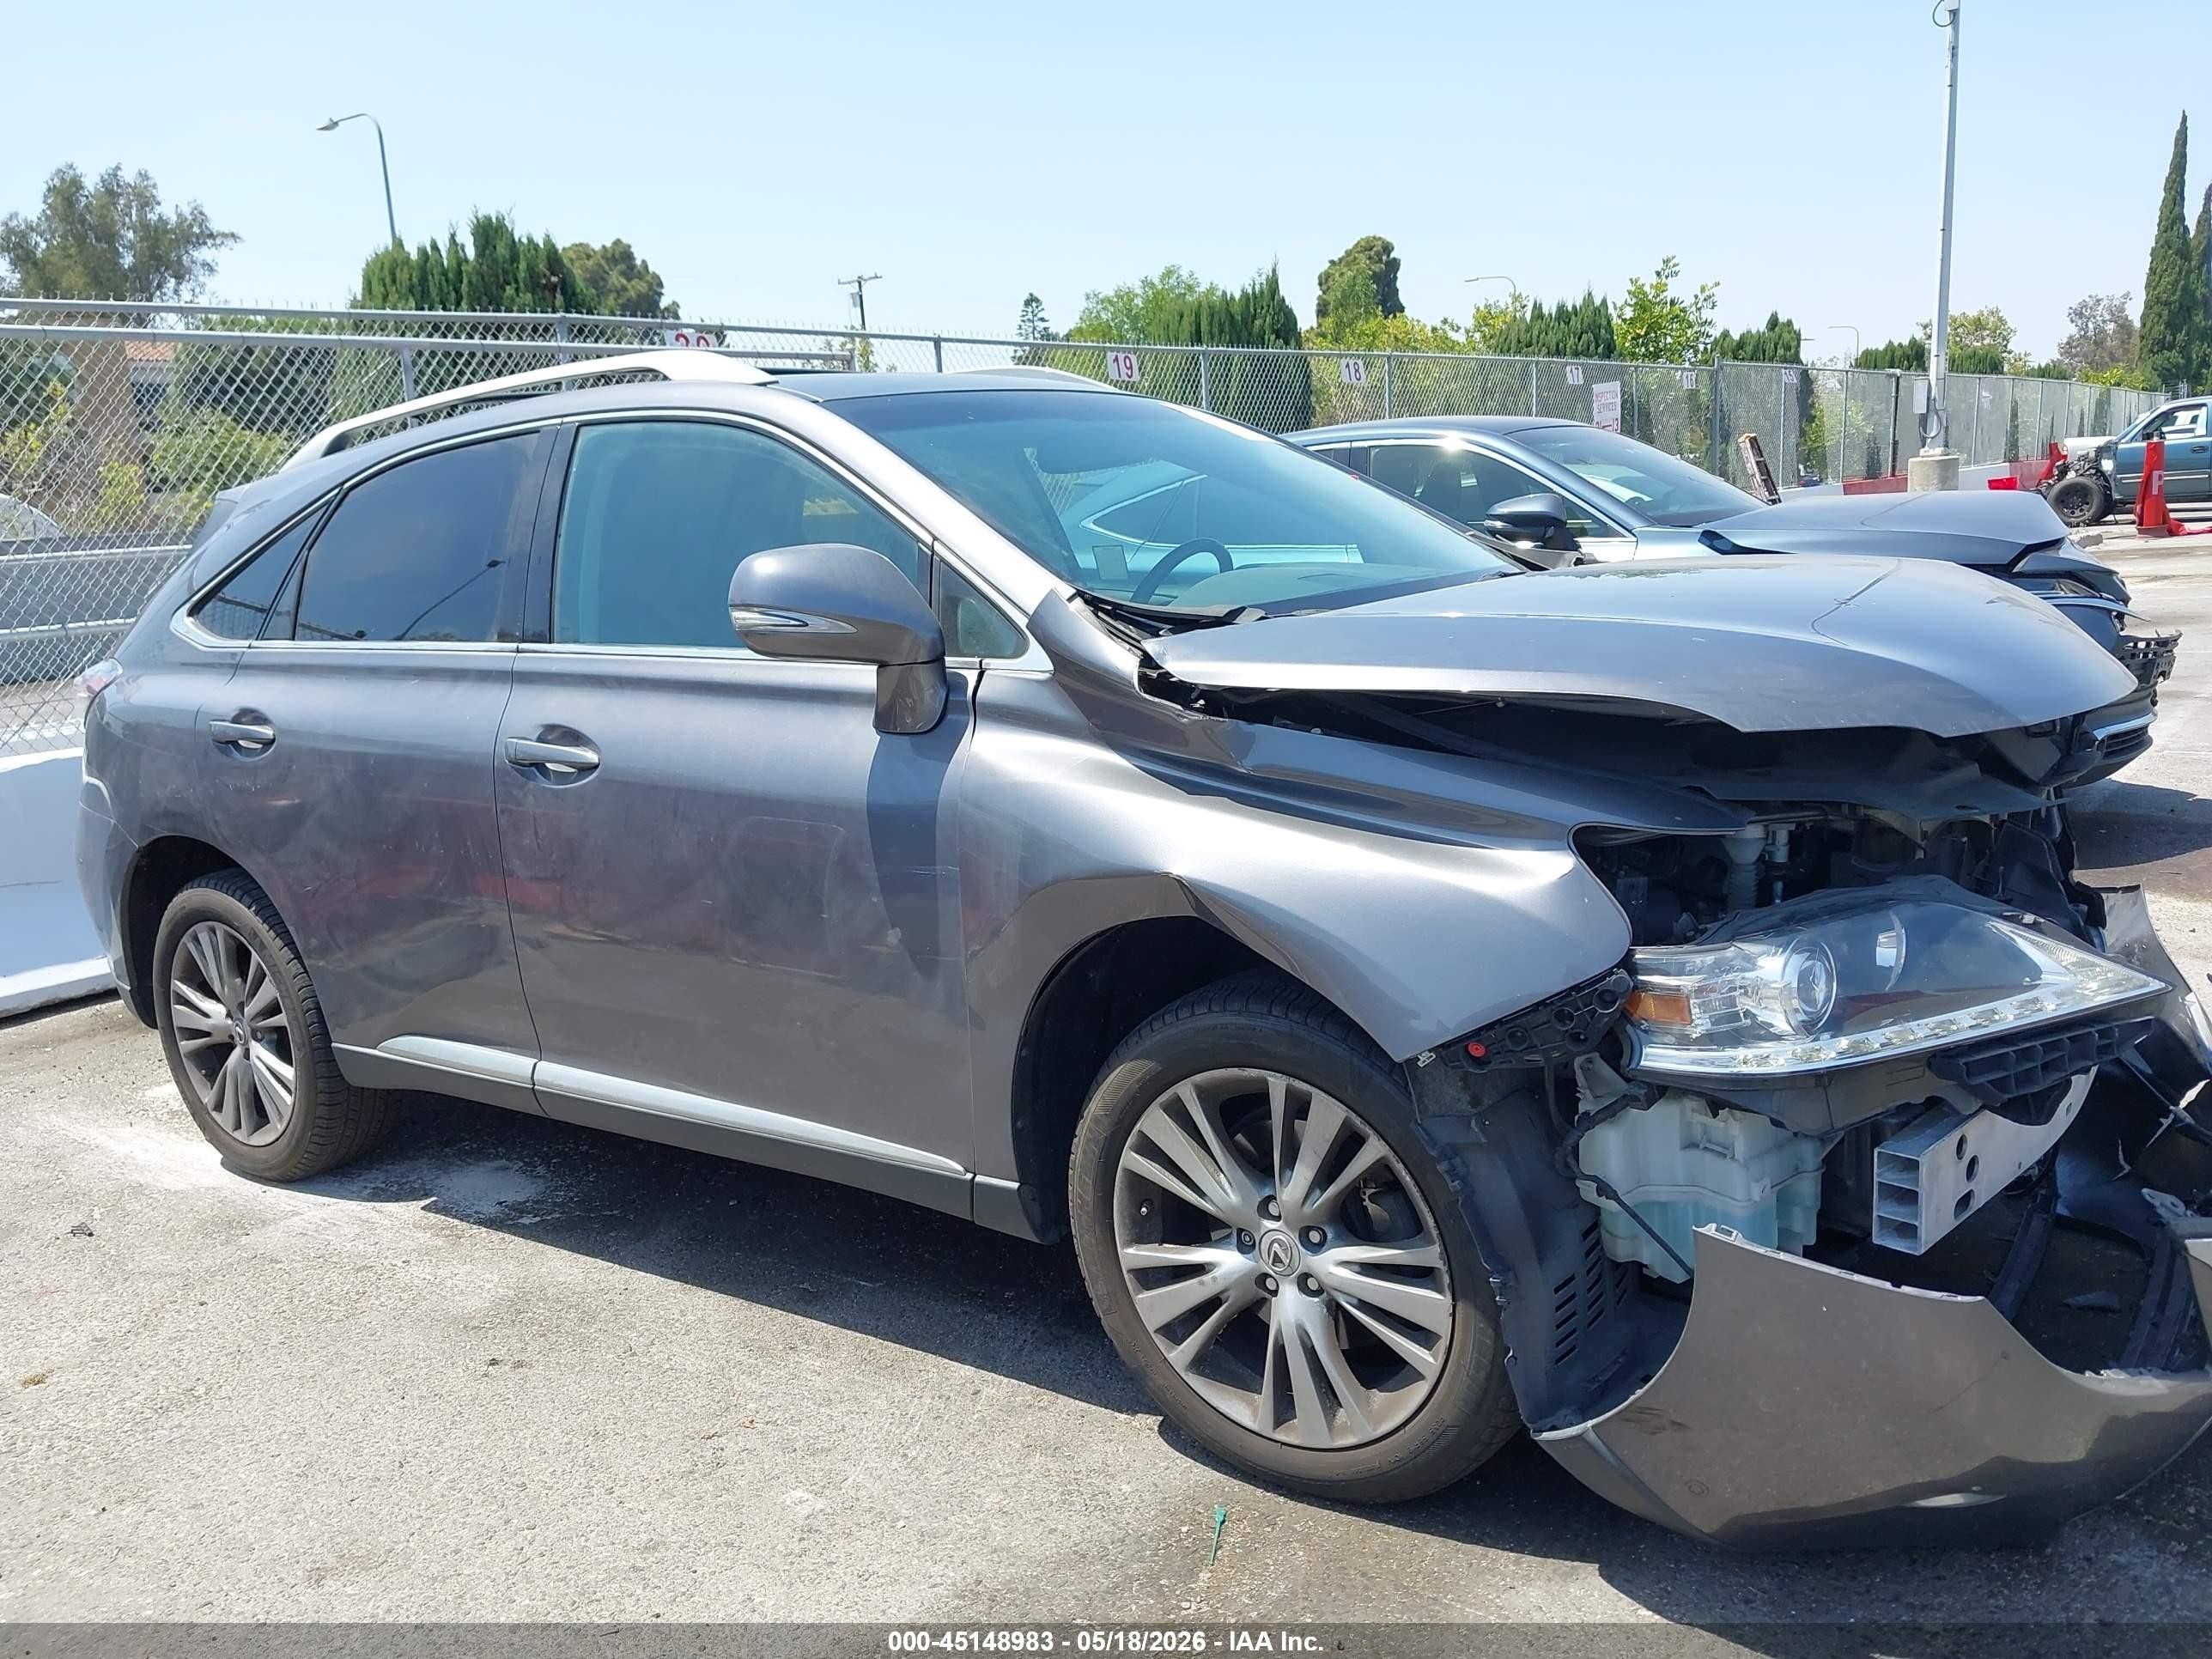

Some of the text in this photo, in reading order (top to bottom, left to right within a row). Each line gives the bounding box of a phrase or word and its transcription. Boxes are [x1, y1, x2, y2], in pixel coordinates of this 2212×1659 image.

[1113, 354, 1133, 379] 19
[1345, 361, 1362, 381] 18
[1570, 366, 1580, 384] 17
[1685, 373, 1695, 388] 16
